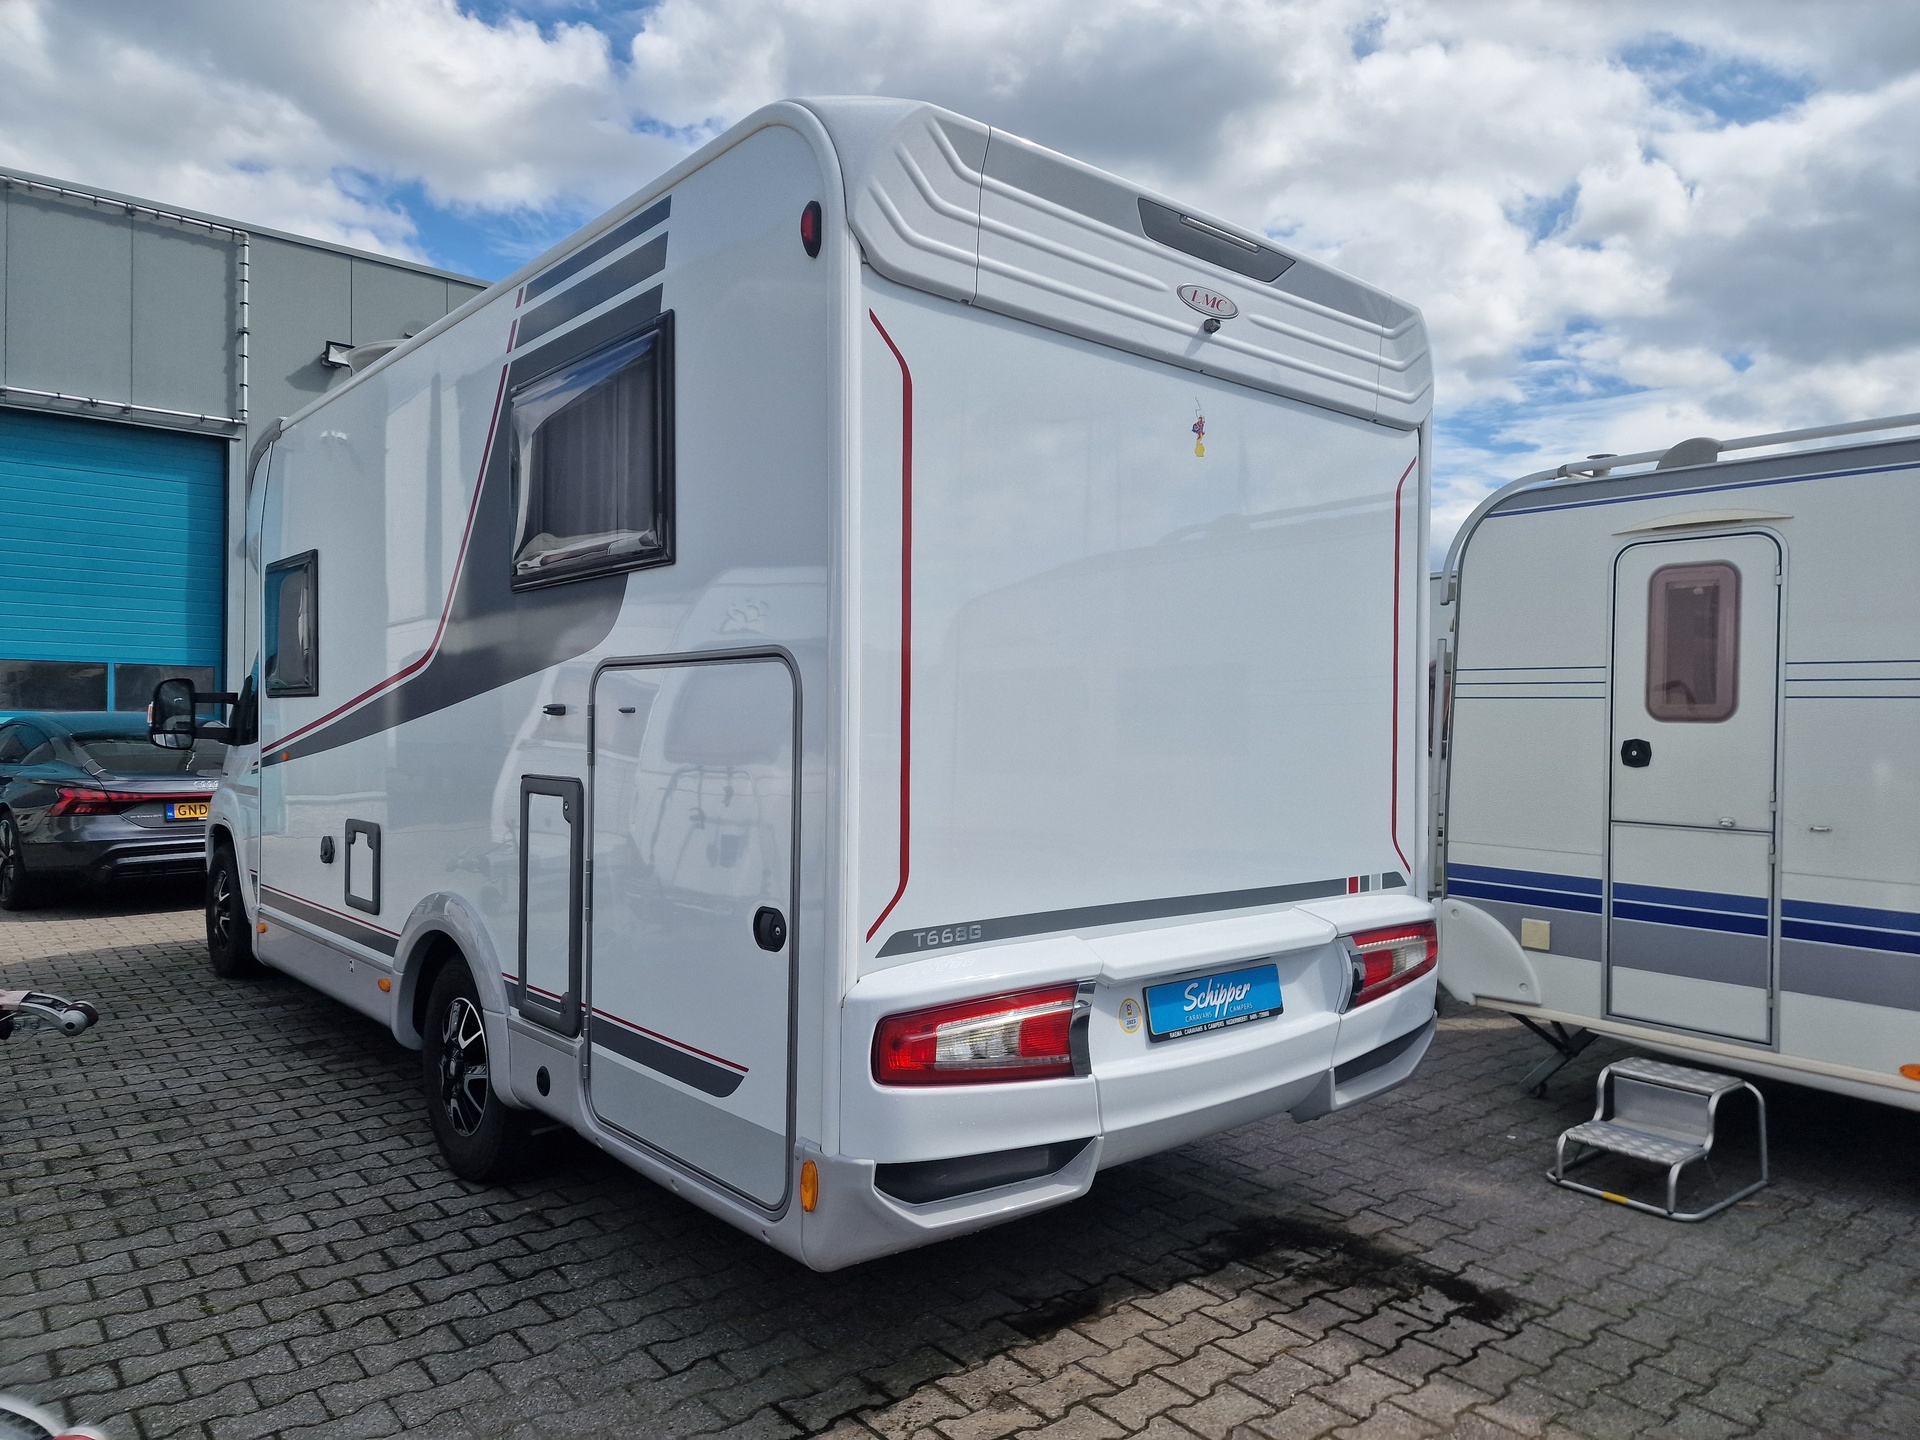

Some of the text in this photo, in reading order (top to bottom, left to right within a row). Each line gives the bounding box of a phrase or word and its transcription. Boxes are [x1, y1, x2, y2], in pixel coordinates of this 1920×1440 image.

[1191, 290, 1227, 312] LMC
[913, 924, 982, 947] T668G
[1184, 979, 1251, 1018] Schipper
[1185, 1002, 1253, 1023] CARAVANS CAMPERS
